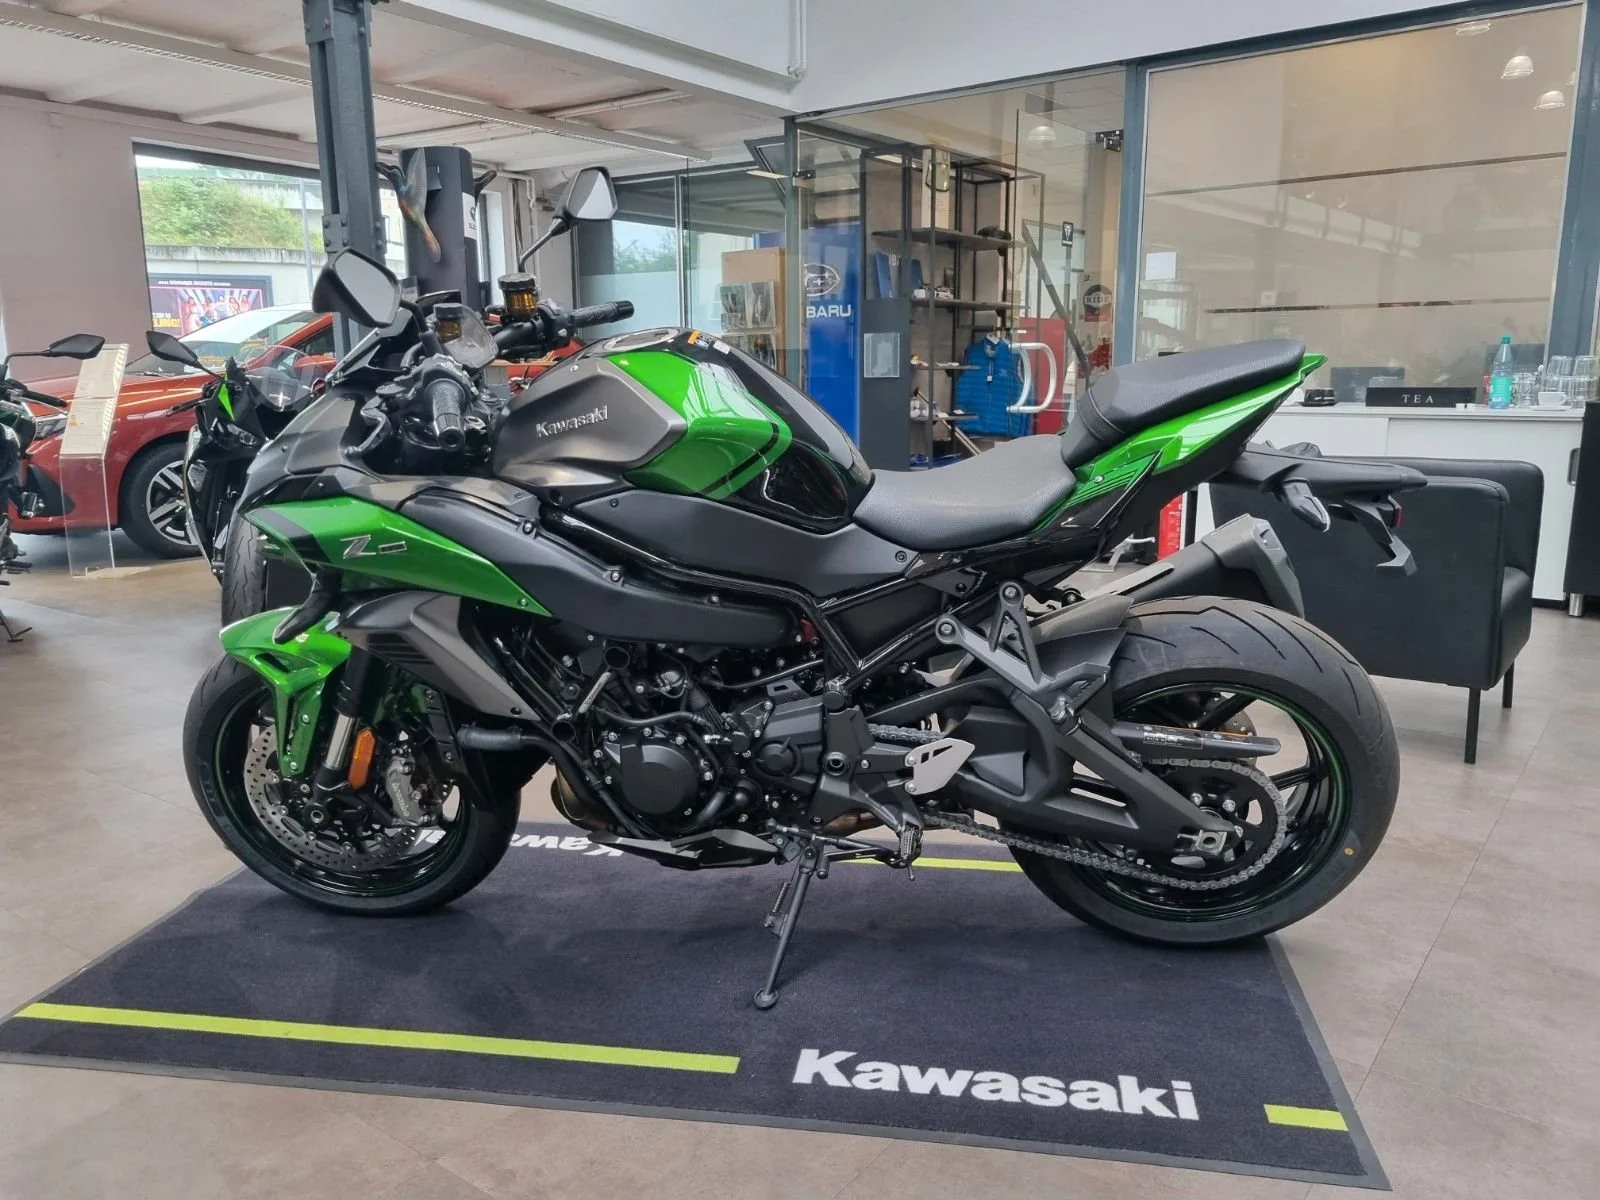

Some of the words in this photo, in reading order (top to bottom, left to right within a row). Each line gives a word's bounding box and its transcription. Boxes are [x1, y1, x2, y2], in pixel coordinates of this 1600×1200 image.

[1086, 295, 1110, 303] RIDE
[806, 304, 851, 318] BARU
[1402, 394, 1434, 404] TEA
[535, 405, 607, 437] Kawasaki
[792, 1048, 1200, 1121] Kawasaki
